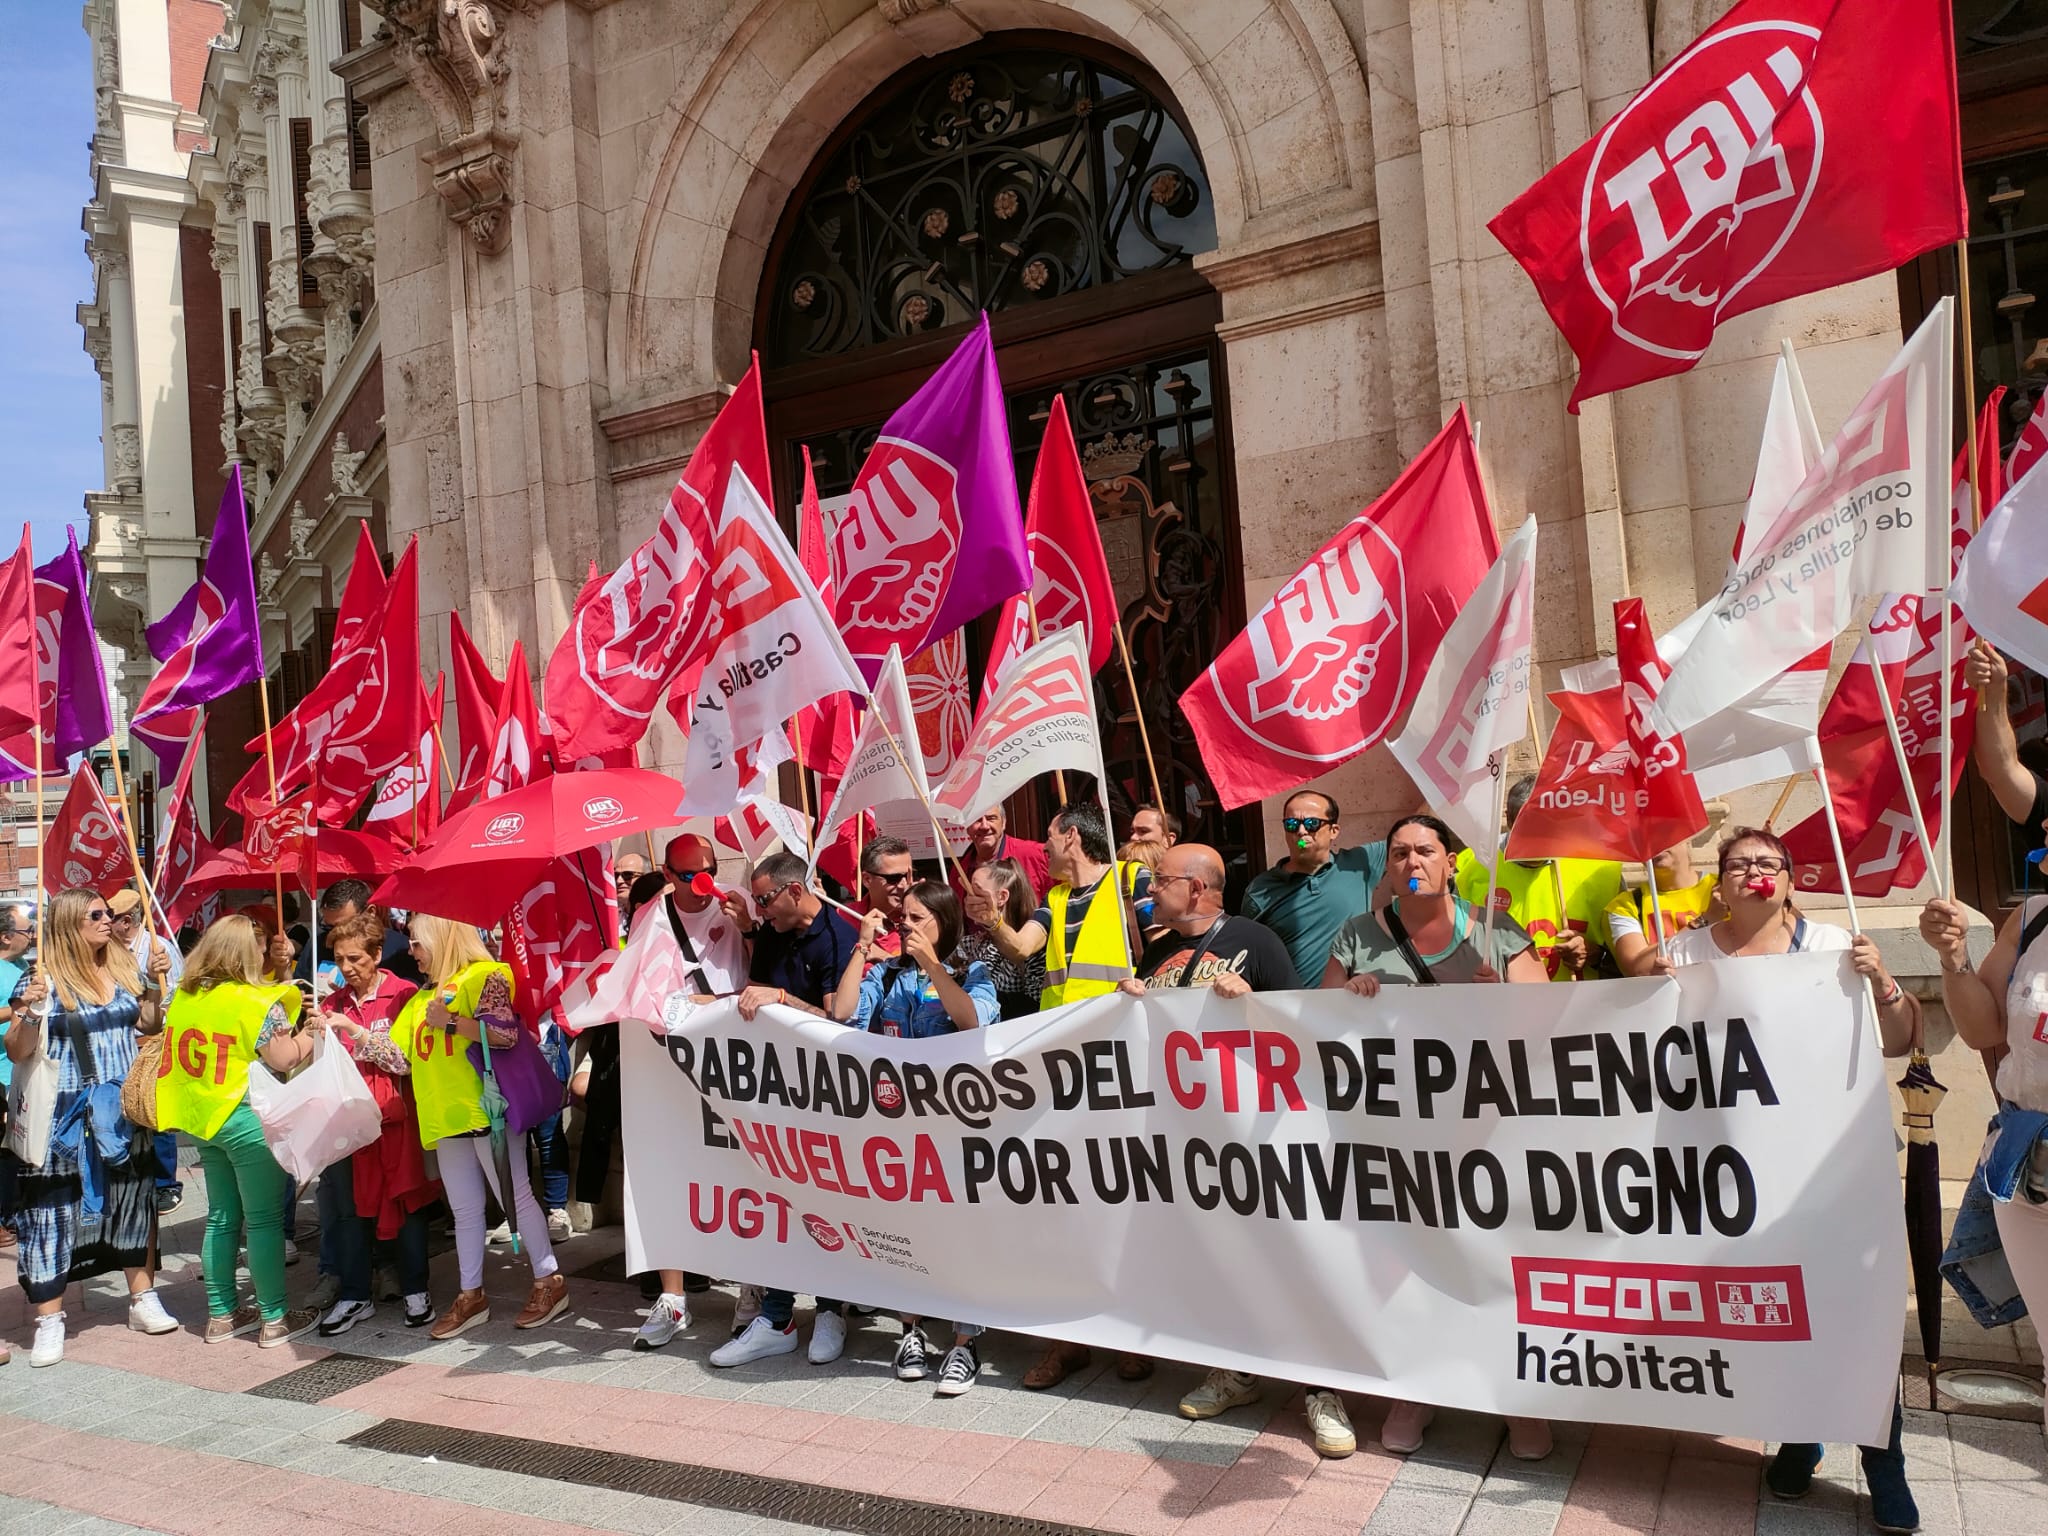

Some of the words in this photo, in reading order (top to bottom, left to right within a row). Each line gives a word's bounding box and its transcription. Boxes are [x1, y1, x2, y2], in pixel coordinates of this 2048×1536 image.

[490, 816, 520, 831] UGT
[587, 800, 614, 814] UGT
[649, 1029, 1035, 1129] RABAJADOR@S
[1041, 1040, 1155, 1111] DEL
[1164, 1029, 1307, 1112] CTR
[1316, 1038, 1400, 1117] DE
[1413, 1018, 1780, 1119] PALENCIA
[876, 1083, 897, 1095] UGT
[701, 1096, 740, 1150] E
[731, 1116, 955, 1204] HUELGA
[961, 1134, 1079, 1205] POR
[1086, 1133, 1174, 1205] UN
[1184, 1135, 1509, 1231] CONVENIO
[1526, 1144, 1757, 1237] DIGNO
[689, 1182, 794, 1244] UGT
[861, 1226, 912, 1245] Servicios
[874, 1251, 930, 1275] Palencia
[1528, 1270, 1705, 1323] CCOO
[1516, 1331, 1734, 1399] hábitat
